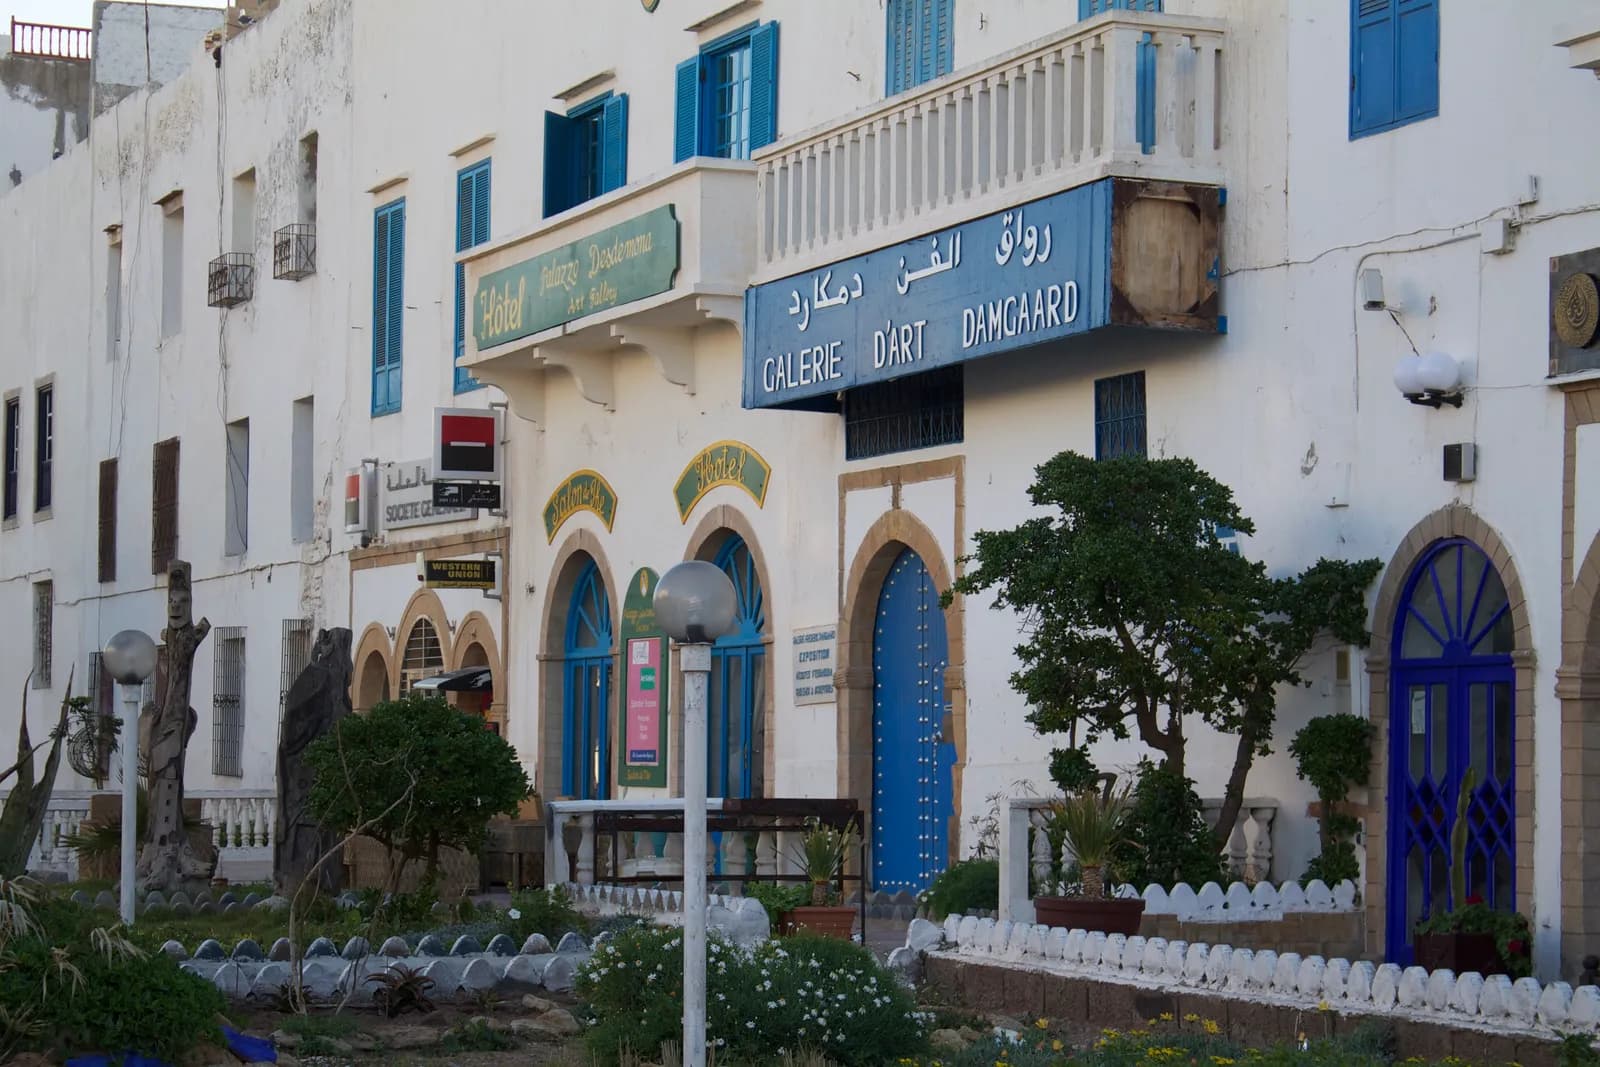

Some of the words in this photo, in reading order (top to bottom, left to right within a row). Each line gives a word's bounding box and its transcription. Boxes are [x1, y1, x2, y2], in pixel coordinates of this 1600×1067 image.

[588, 231, 653, 279] Desdemona
[895, 231, 961, 295] الفن
[995, 210, 1052, 267] رواق
[480, 274, 526, 341] Hôtel
[788, 270, 864, 332] دمكارد
[763, 340, 843, 393] GALERIE
[873, 319, 928, 369] D'ART
[962, 280, 1079, 349] DAMGAARD
[695, 446, 746, 491] Hotel
[552, 480, 582, 525] Salon
[432, 562, 481, 570] WESTERN
